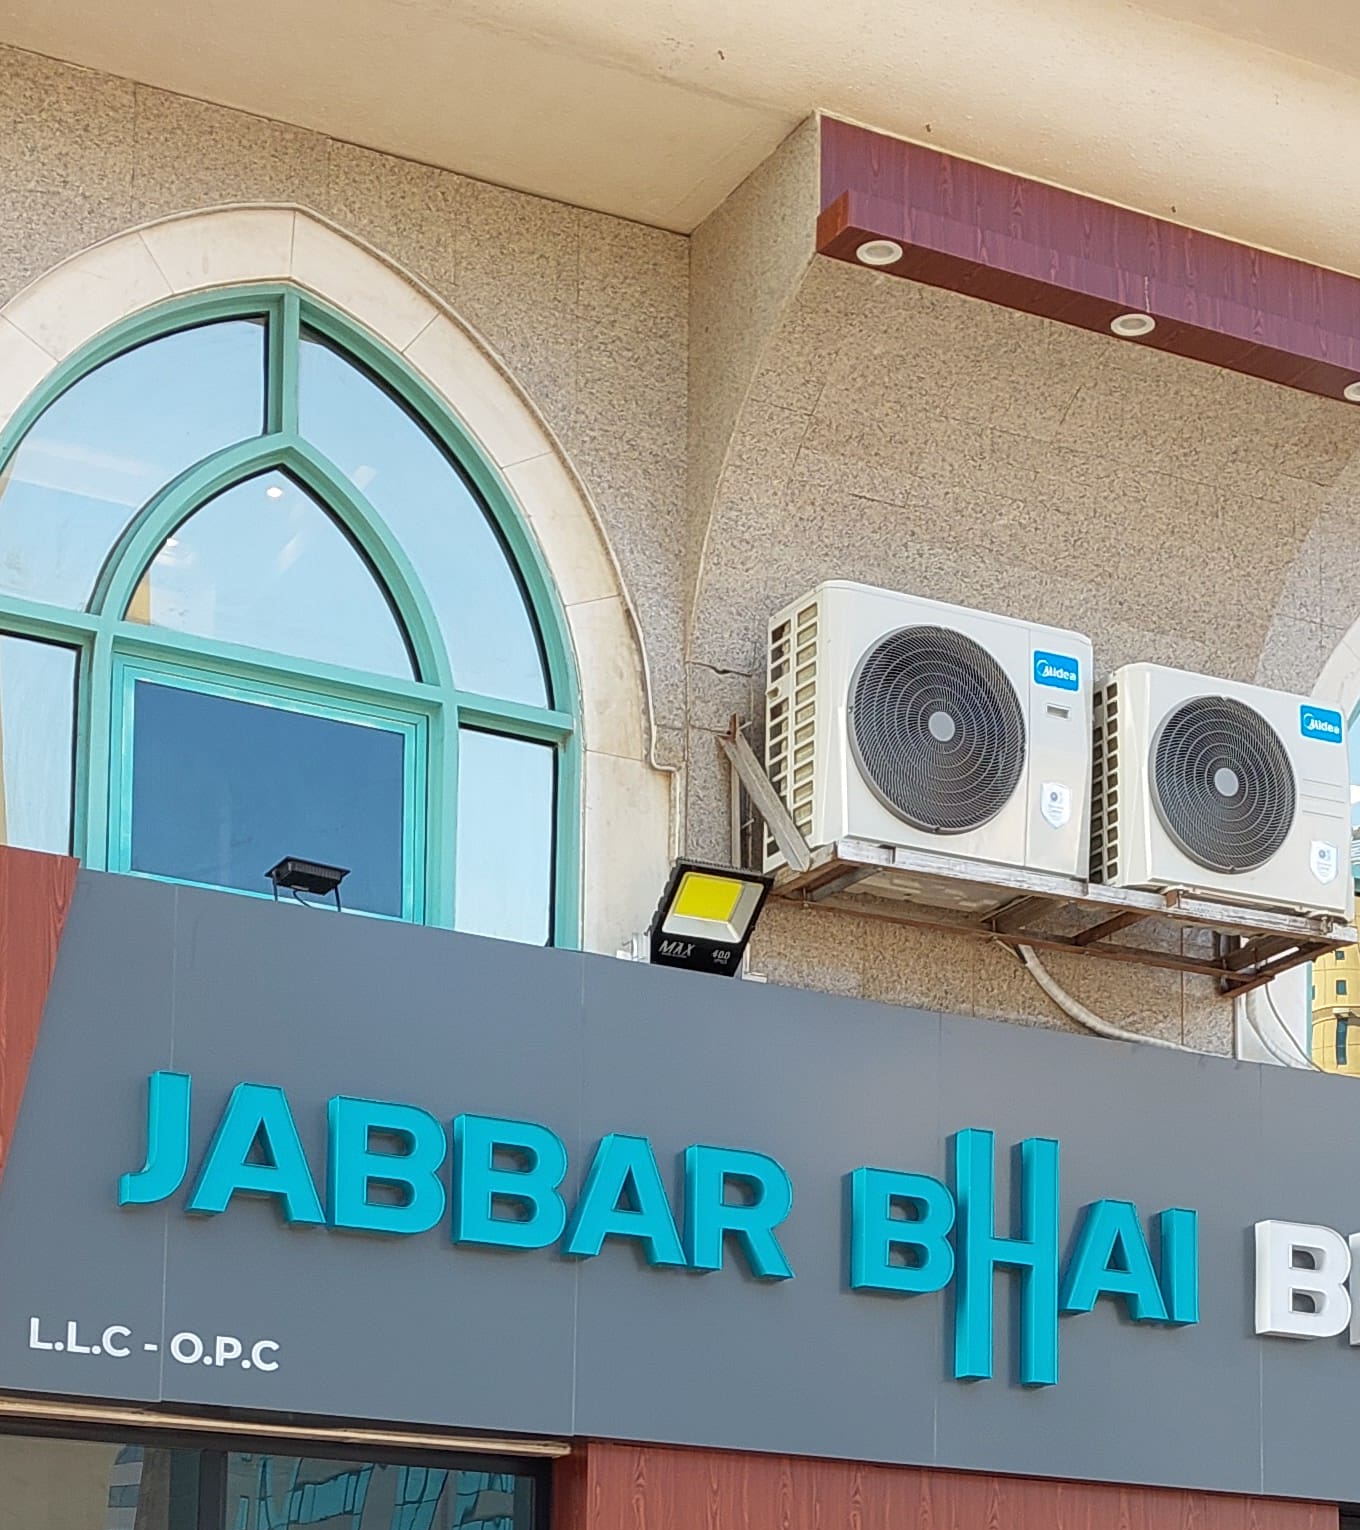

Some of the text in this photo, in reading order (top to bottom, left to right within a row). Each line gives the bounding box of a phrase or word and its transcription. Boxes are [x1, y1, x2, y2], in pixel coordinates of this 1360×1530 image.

[659, 940, 695, 956] MAX
[117, 1070, 795, 1280] JABBAR
[849, 1128, 1199, 1388] BHAI
[29, 1317, 132, 1358] L.L.C
[170, 1332, 280, 1372] O.P.C
